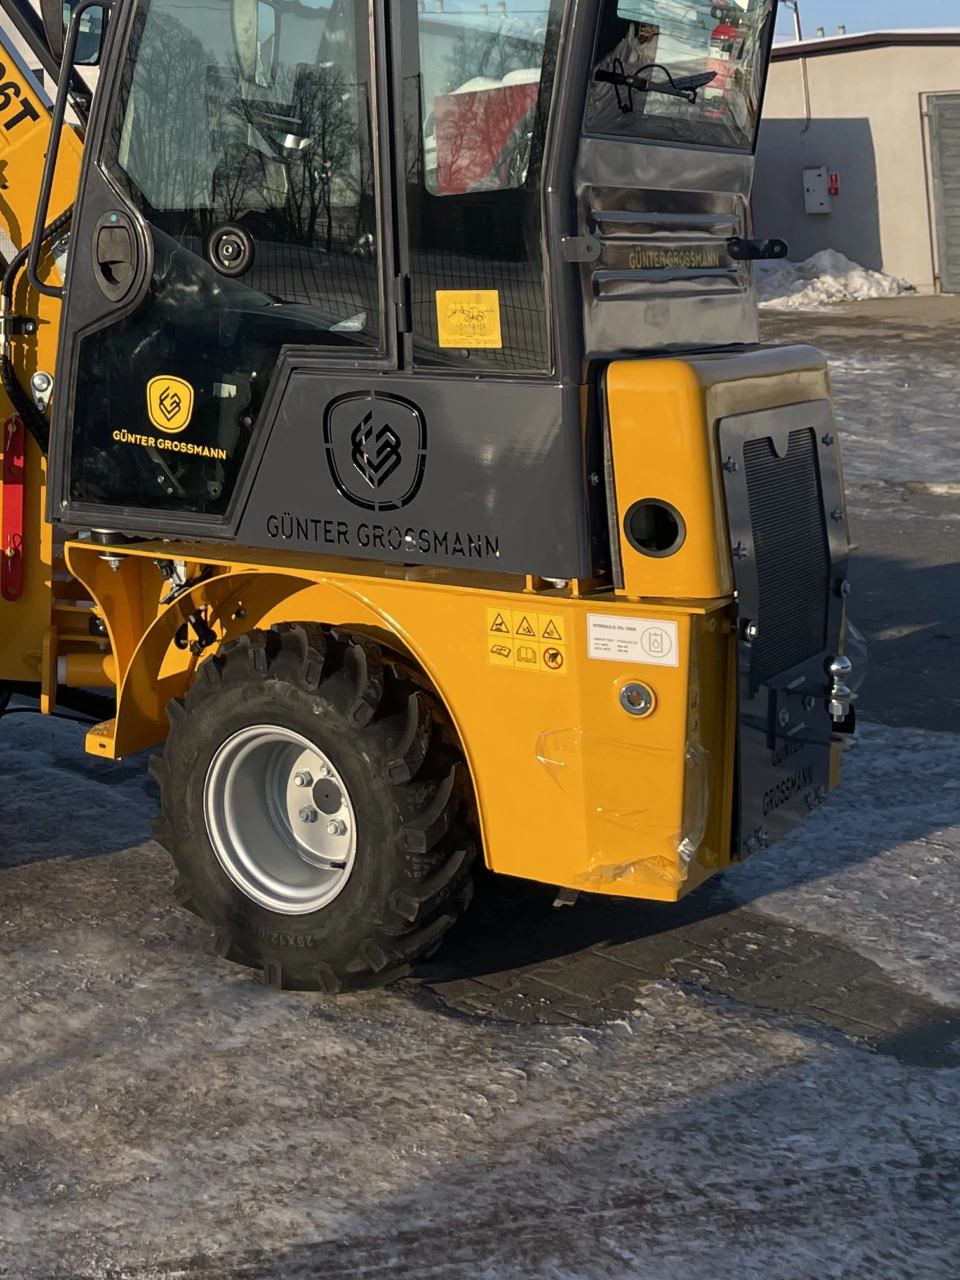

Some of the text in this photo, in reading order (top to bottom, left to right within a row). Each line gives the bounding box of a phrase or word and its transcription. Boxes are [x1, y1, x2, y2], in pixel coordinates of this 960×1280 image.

[629, 246, 720, 269] GÜNTER GROSSMANN
[112, 428, 227, 460] GÜNTER GROSSMANN
[266, 511, 500, 560] GÜNTER GROSSMANN
[763, 763, 813, 816] GROSSMANN
